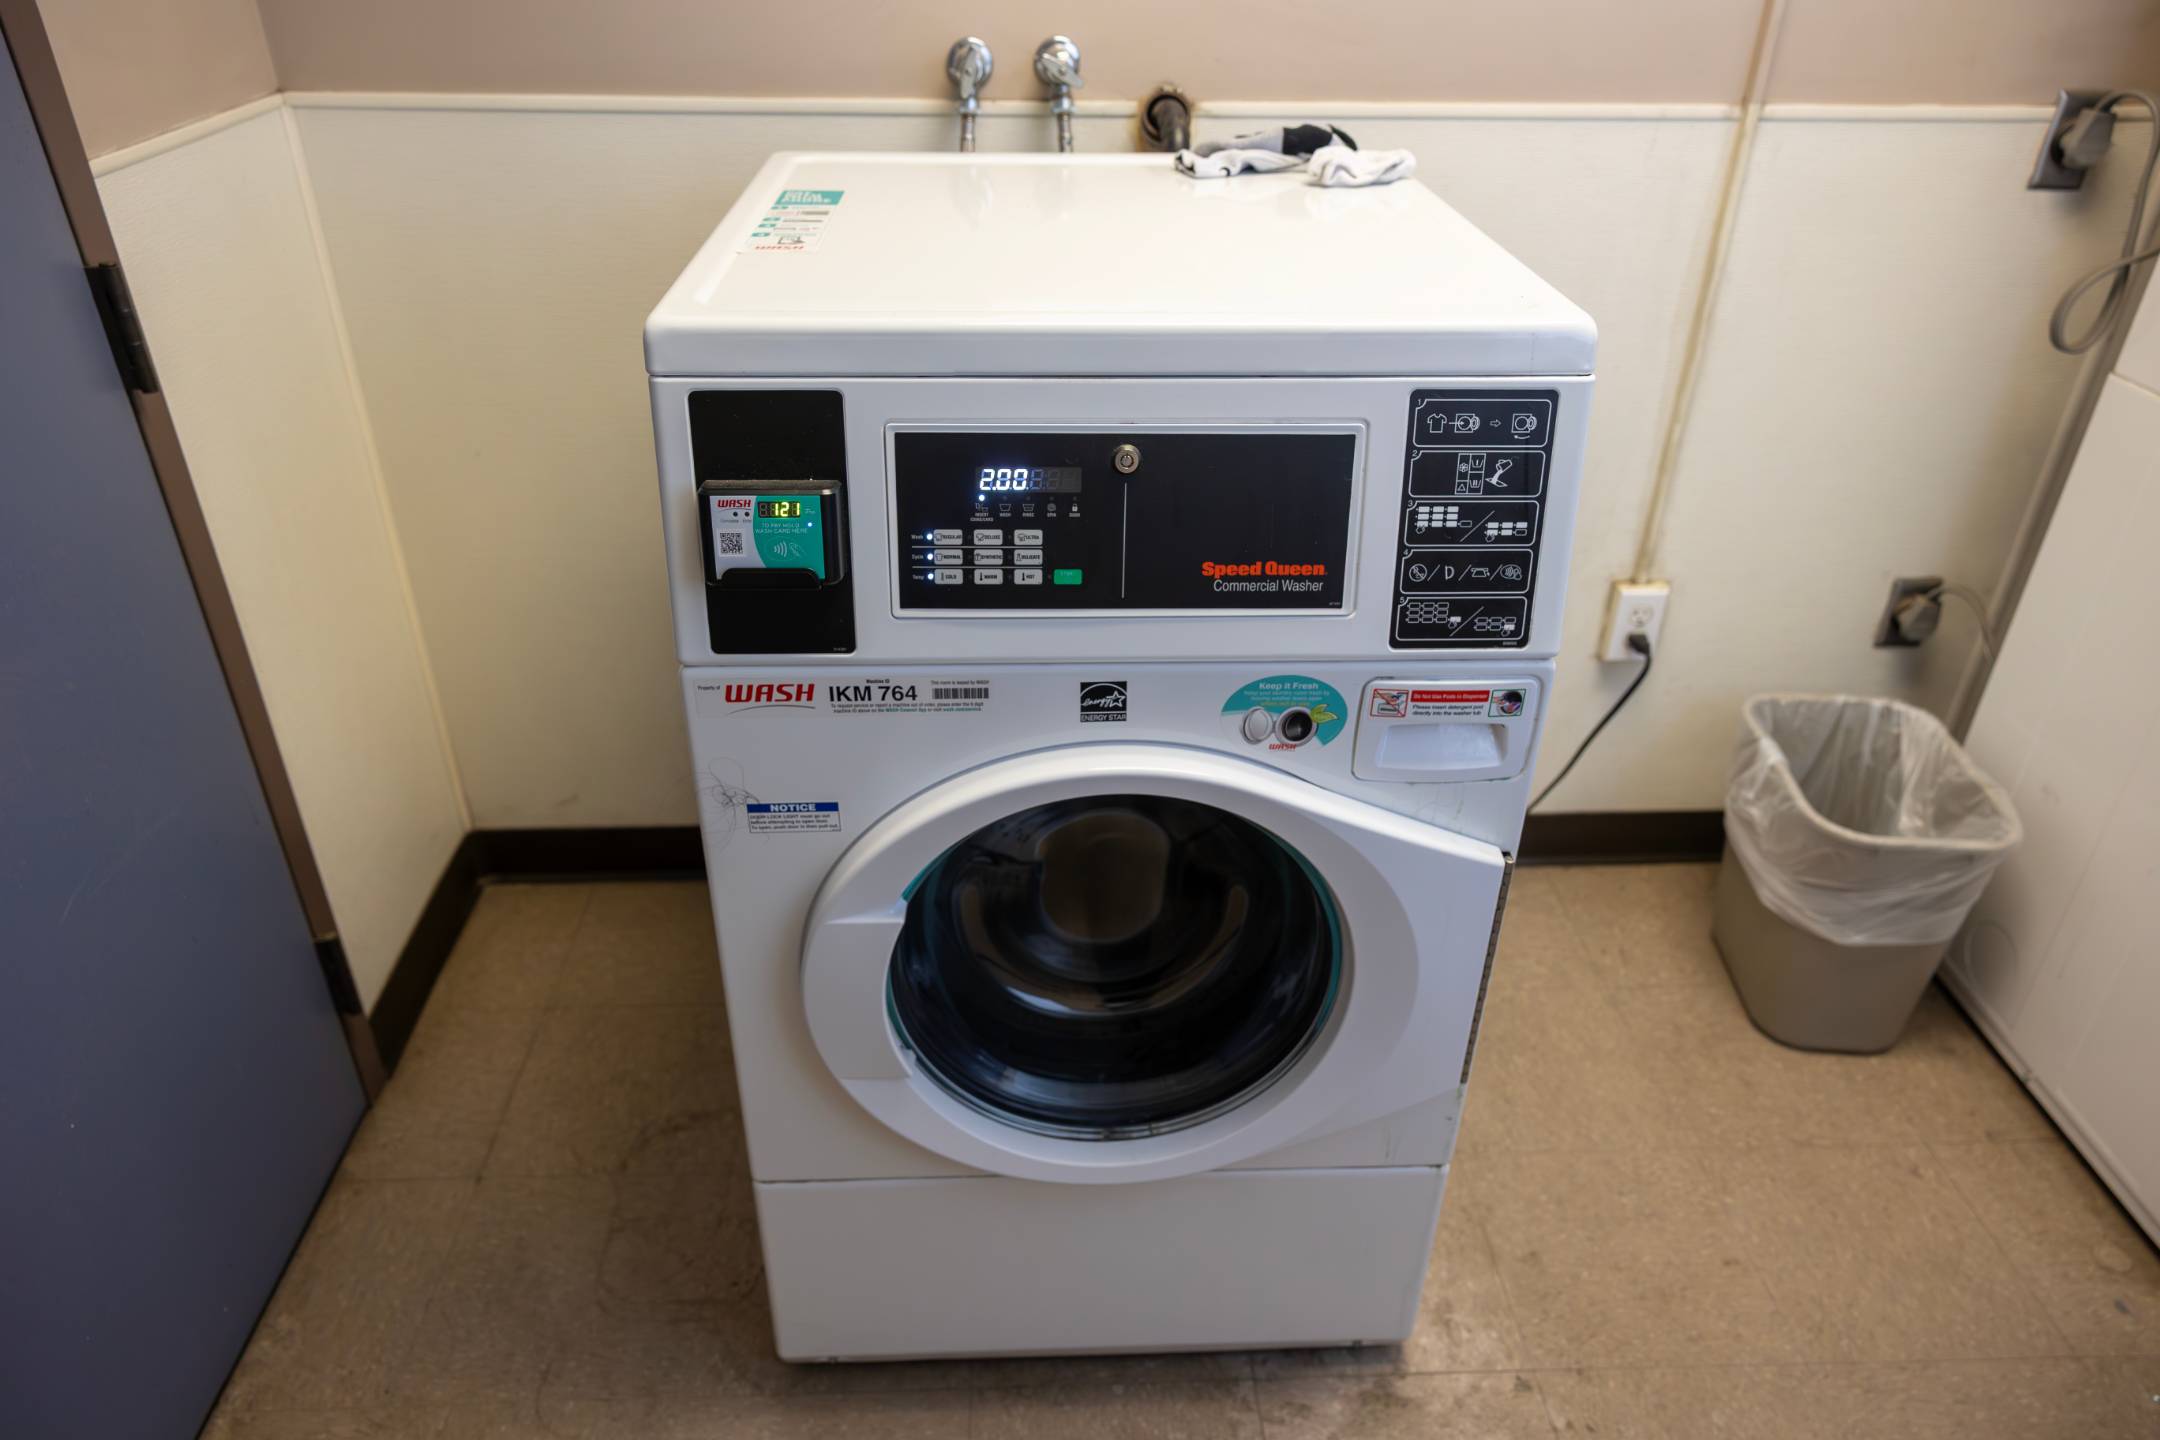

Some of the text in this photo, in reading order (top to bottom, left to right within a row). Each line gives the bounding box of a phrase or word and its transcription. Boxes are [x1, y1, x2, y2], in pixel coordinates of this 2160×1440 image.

[717, 499, 751, 508] WASH
[1201, 560, 1325, 579] Speed Queen
[1213, 579, 1324, 592] Commercial Washer
[724, 683, 815, 703] WASH
[829, 684, 918, 702] IKM 764
[770, 803, 816, 812] NOTICE
